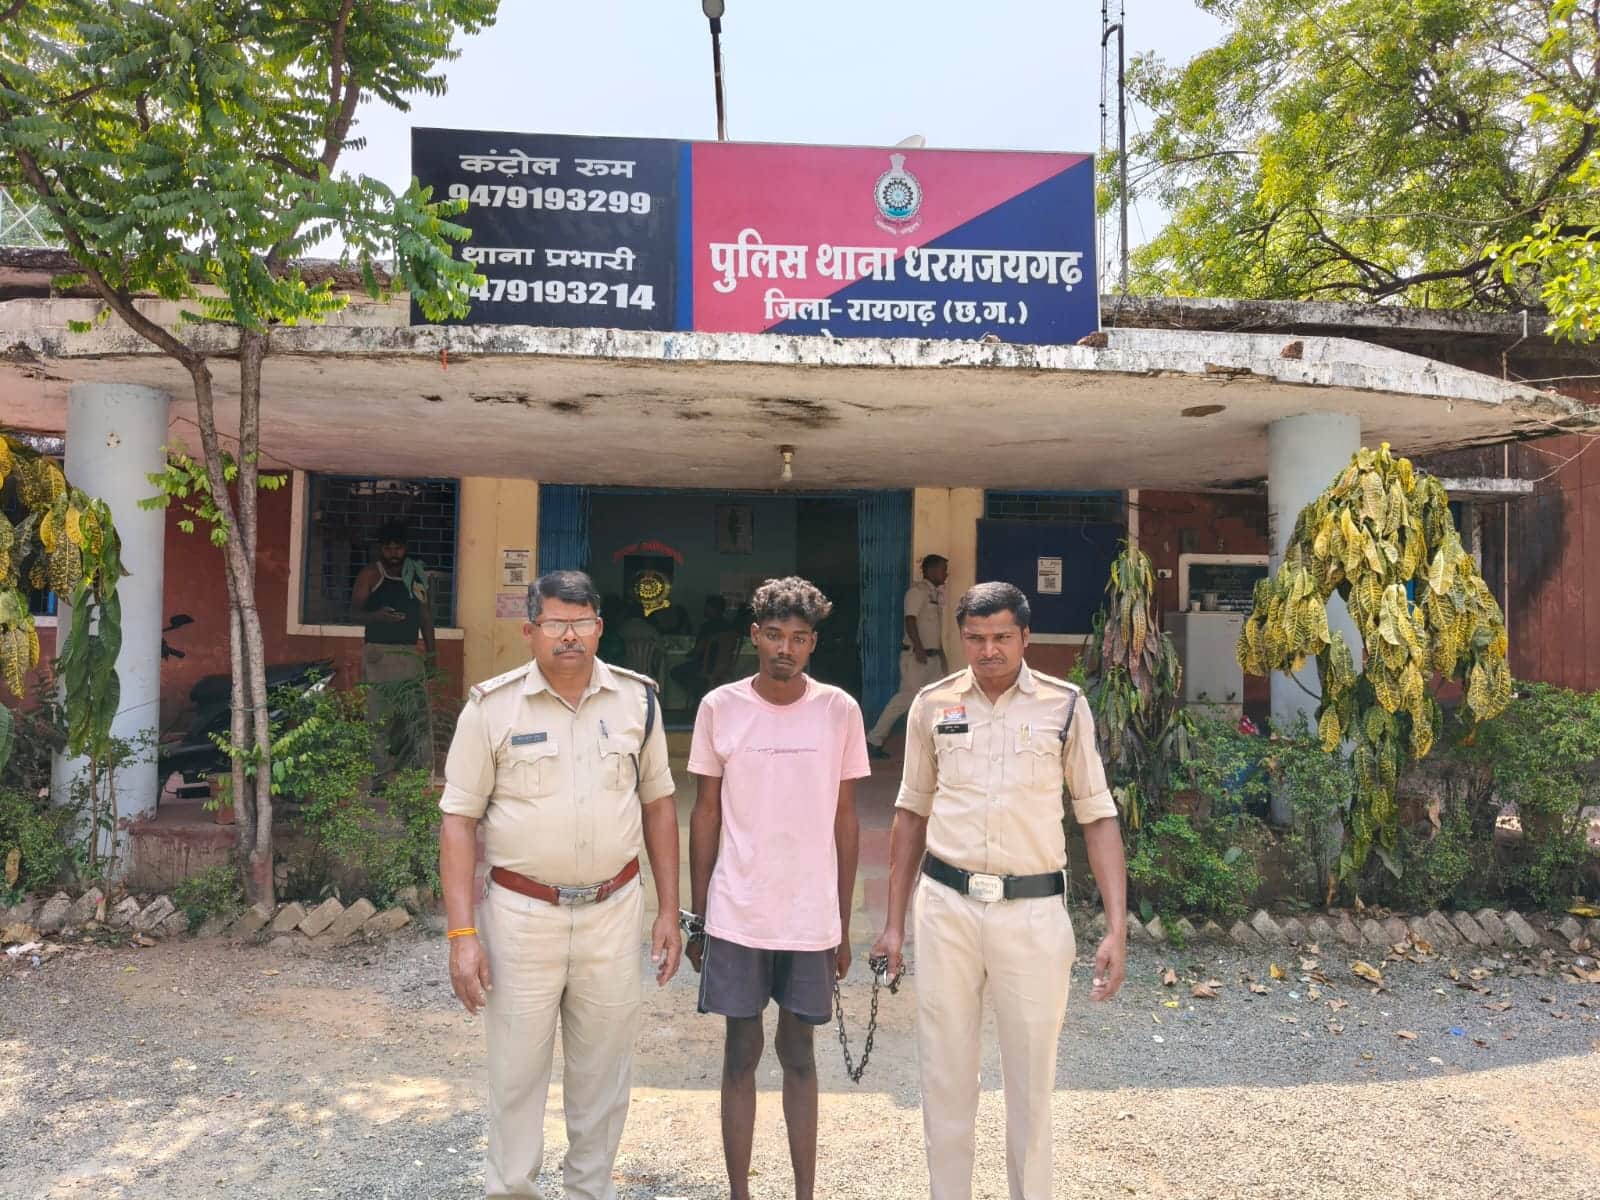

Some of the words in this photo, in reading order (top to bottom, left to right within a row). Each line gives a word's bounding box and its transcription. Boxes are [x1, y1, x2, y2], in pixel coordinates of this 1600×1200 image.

[449, 183, 651, 214] 9479193299
[461, 246, 536, 266] थाना
[544, 246, 637, 271] प्रभारी
[709, 228, 808, 293] पुलिस
[815, 243, 898, 281] थाना
[904, 246, 1083, 292] धरमजयगढ़
[456, 279, 656, 310] 479193214
[847, 299, 937, 327] रायगढ़
